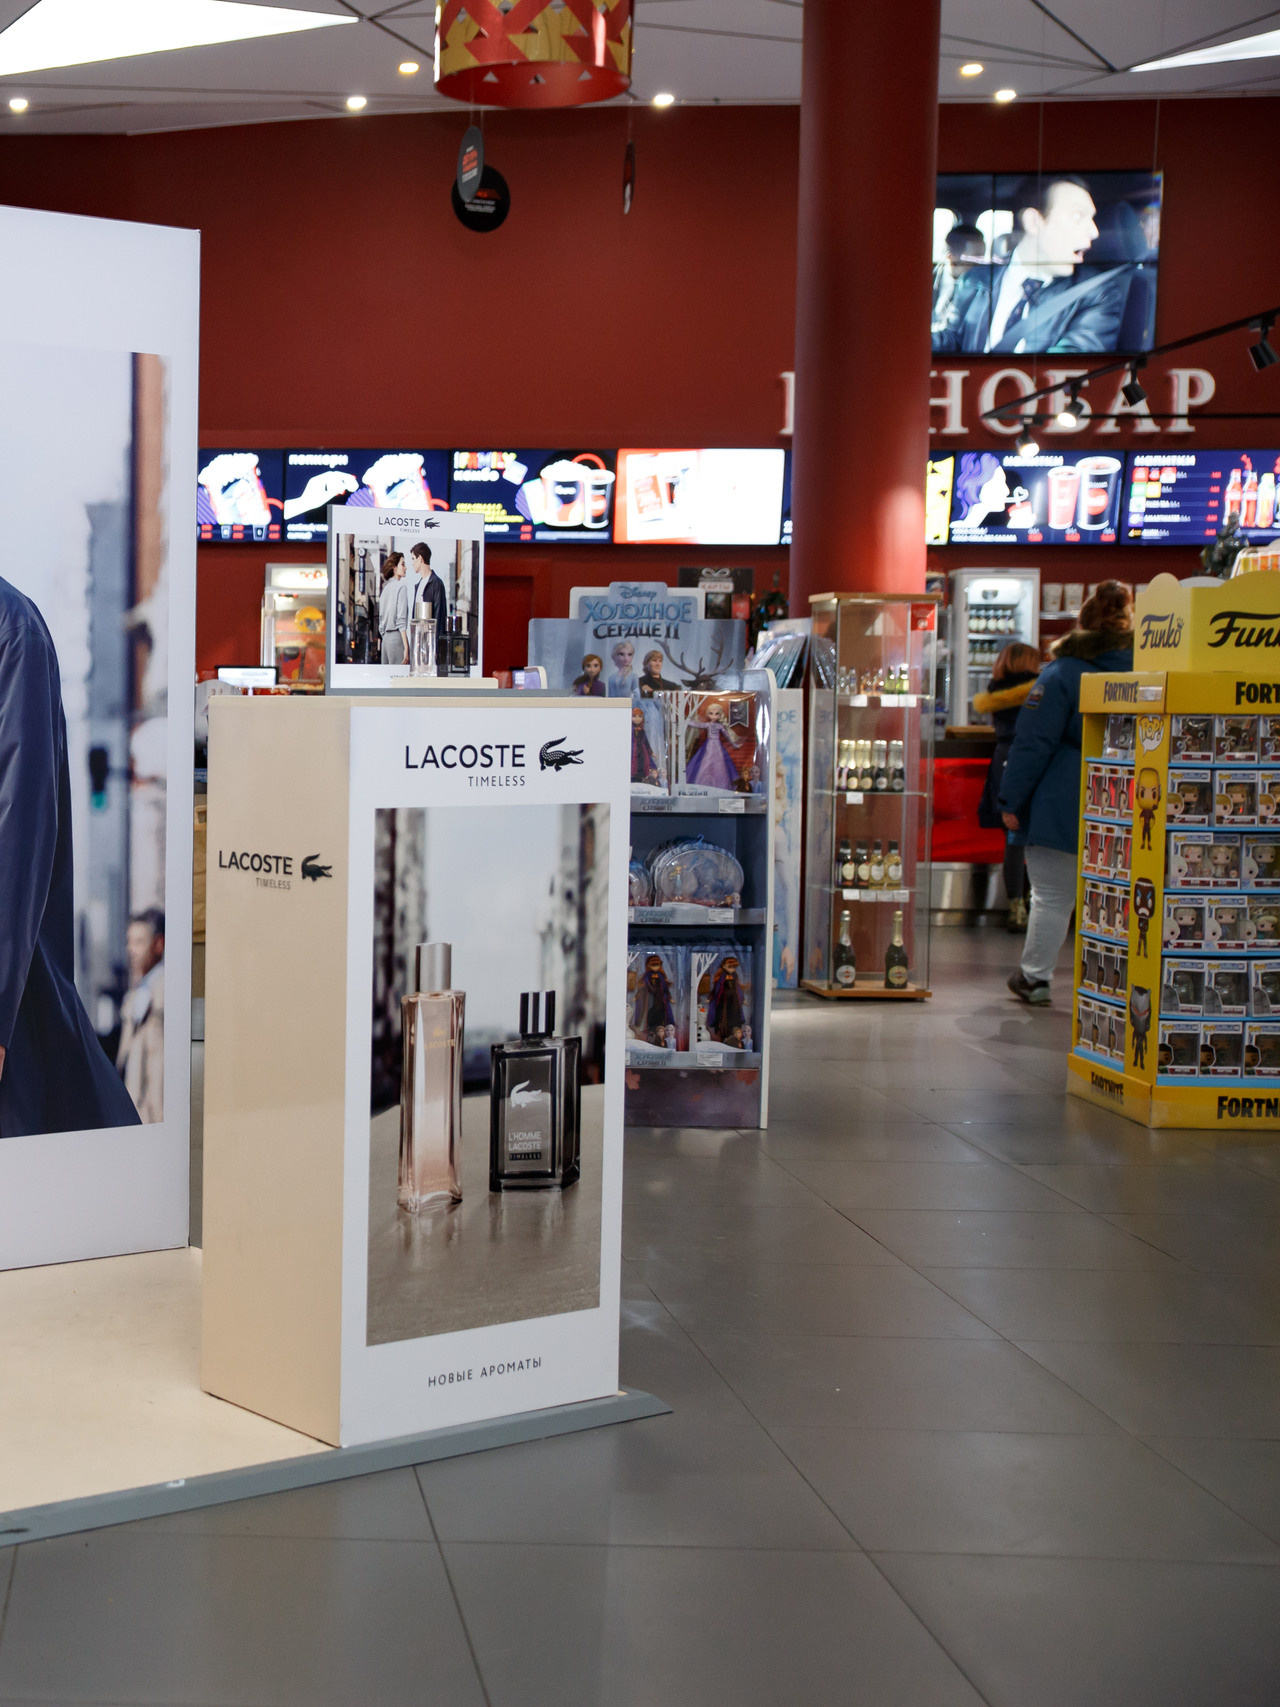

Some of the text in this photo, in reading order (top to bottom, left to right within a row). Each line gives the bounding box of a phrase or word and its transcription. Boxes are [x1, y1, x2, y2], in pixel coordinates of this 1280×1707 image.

[378, 516, 420, 527] LACOSTE
[619, 586, 657, 601] Disney
[583, 601, 692, 623] ХОЛОДНОЕ
[593, 622, 661, 639] СЕРДЦЕ
[1140, 612, 1183, 650] Funko
[1103, 681, 1139, 704] FORTNITE
[1139, 716, 1164, 742] POP!
[405, 744, 526, 769] LACOSTE
[468, 775, 526, 787] TIMELESS
[219, 850, 293, 875] LACOSTE
[255, 877, 291, 890] TIMELESS
[508, 1131, 542, 1141] L'HOMME
[508, 1141, 542, 1151] LACOSTE
[428, 1357, 541, 1387] НОВЫЕ АРОМАТЫ
